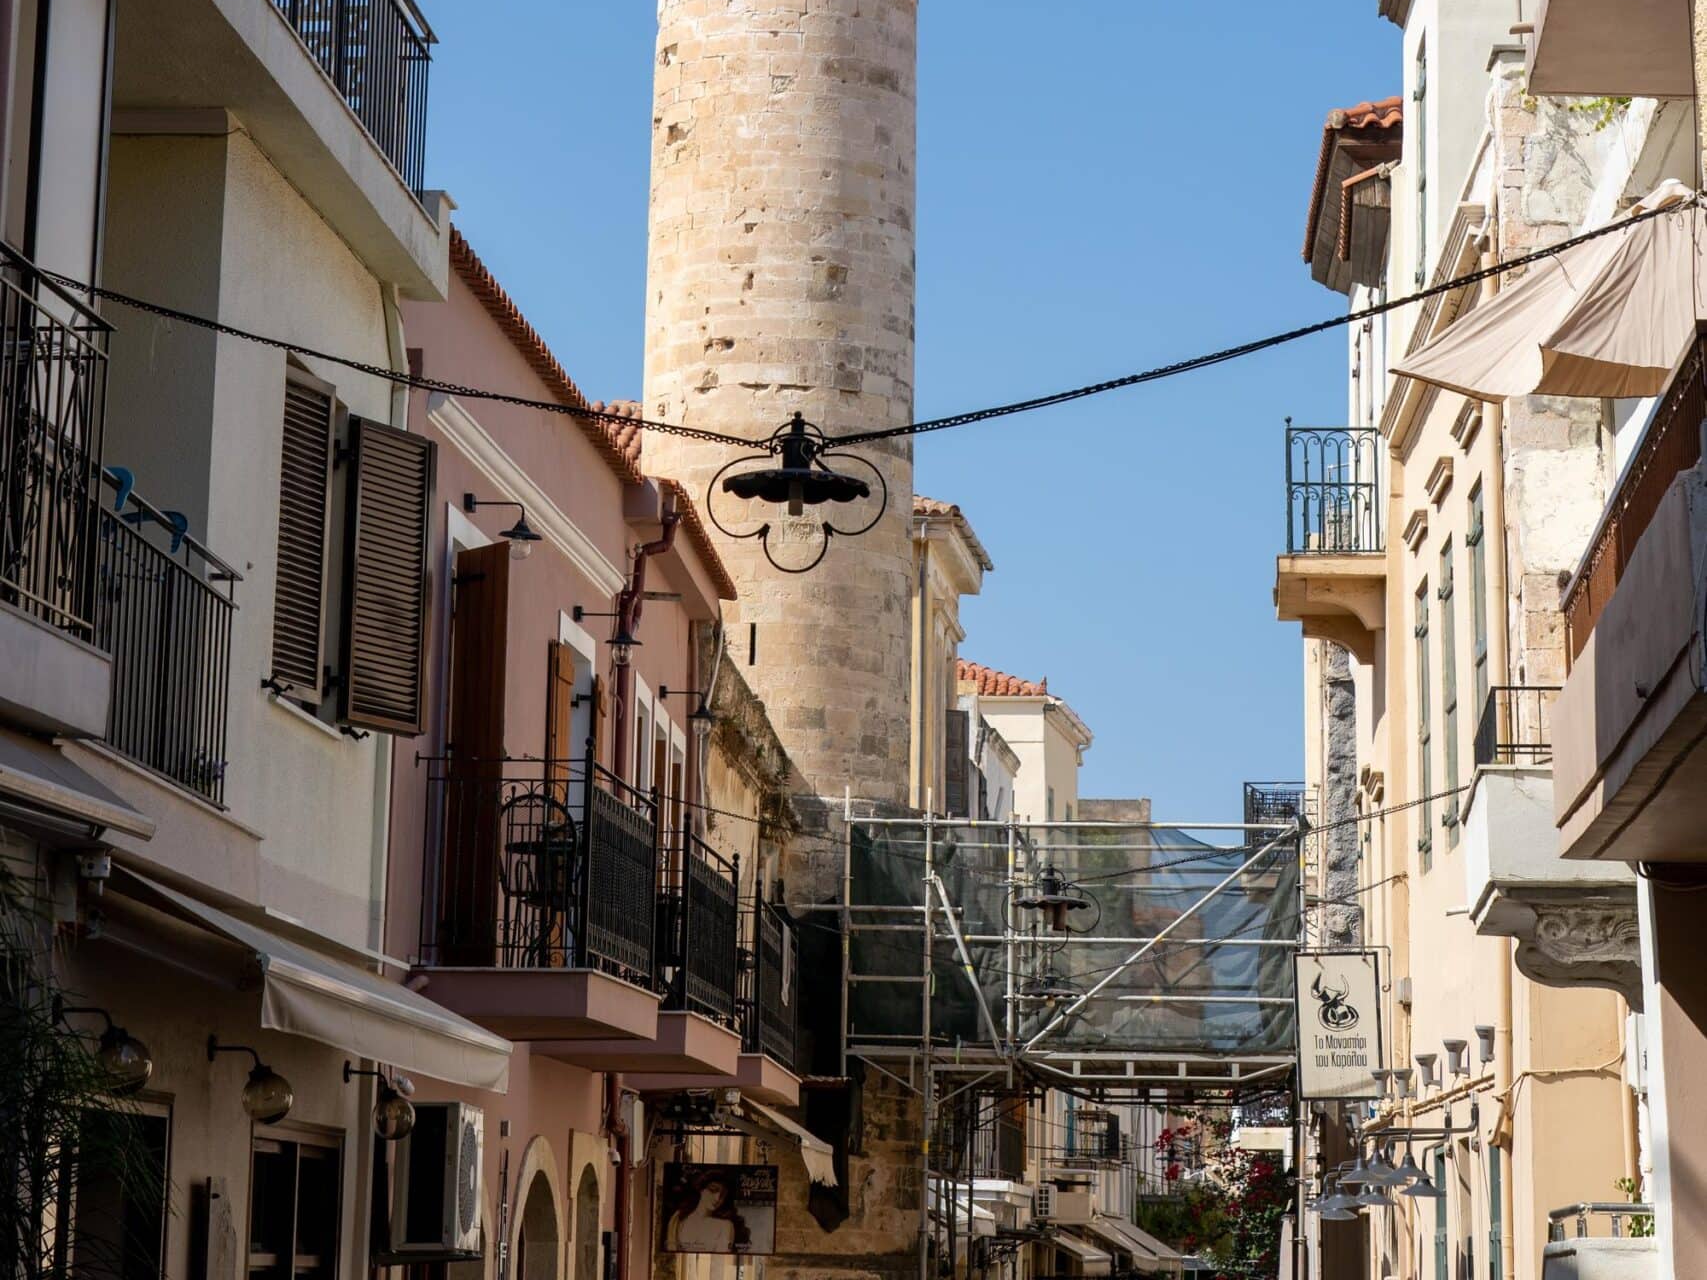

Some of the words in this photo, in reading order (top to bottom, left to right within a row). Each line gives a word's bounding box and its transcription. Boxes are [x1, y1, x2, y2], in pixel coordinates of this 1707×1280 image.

[1314, 1035, 1323, 1049] Το
[1325, 1032, 1367, 1050] Μοναστήρι
[1315, 1055, 1328, 1067] του
